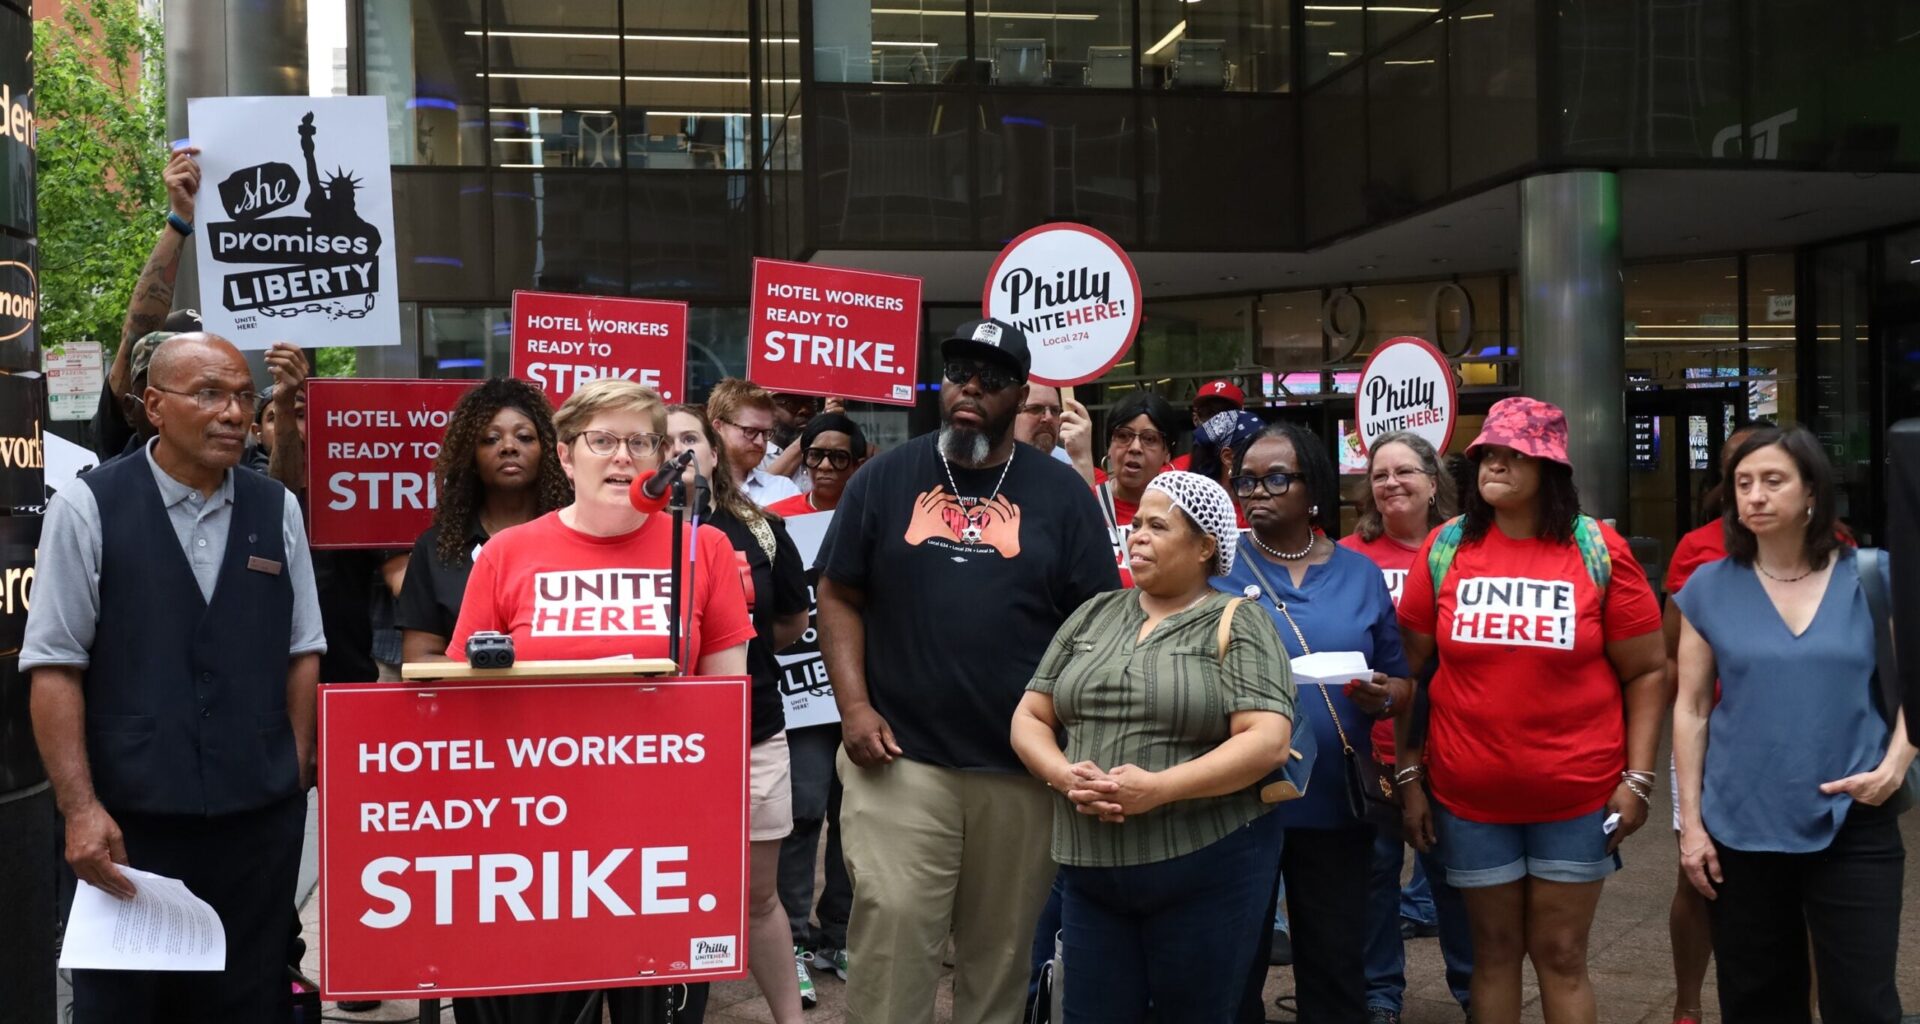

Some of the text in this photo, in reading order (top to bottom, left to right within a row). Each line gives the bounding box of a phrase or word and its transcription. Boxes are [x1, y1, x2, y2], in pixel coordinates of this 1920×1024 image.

[234, 167, 292, 214] she
[218, 227, 368, 255] promises
[229, 261, 373, 306] LIBERTY
[767, 282, 904, 312] HOTEL WORKERS
[1000, 266, 1110, 315] Philly
[234, 316, 257, 325] UNITE
[236, 322, 257, 331] HERE!
[527, 314, 669, 337] HOTEL WORKERS
[766, 307, 849, 329] READY TO
[527, 339, 612, 358] READY TO
[763, 331, 905, 375] STRIKE.
[1042, 334, 1071, 347] Local
[1072, 331, 1090, 341] 274
[1365, 375, 1435, 416] Philly
[326, 410, 455, 428] HOTEL WO
[1366, 406, 1445, 437] UNITEHERE!
[327, 442, 442, 459] READY TO
[539, 573, 672, 602] UNITE
[1460, 581, 1570, 610] UNITE
[1456, 612, 1568, 645] HERE!
[358, 732, 706, 774] HOTEL WORKERS
[359, 795, 568, 833] READY TO
[359, 845, 717, 930] STRIKE.
[696, 941, 728, 954] Philly
